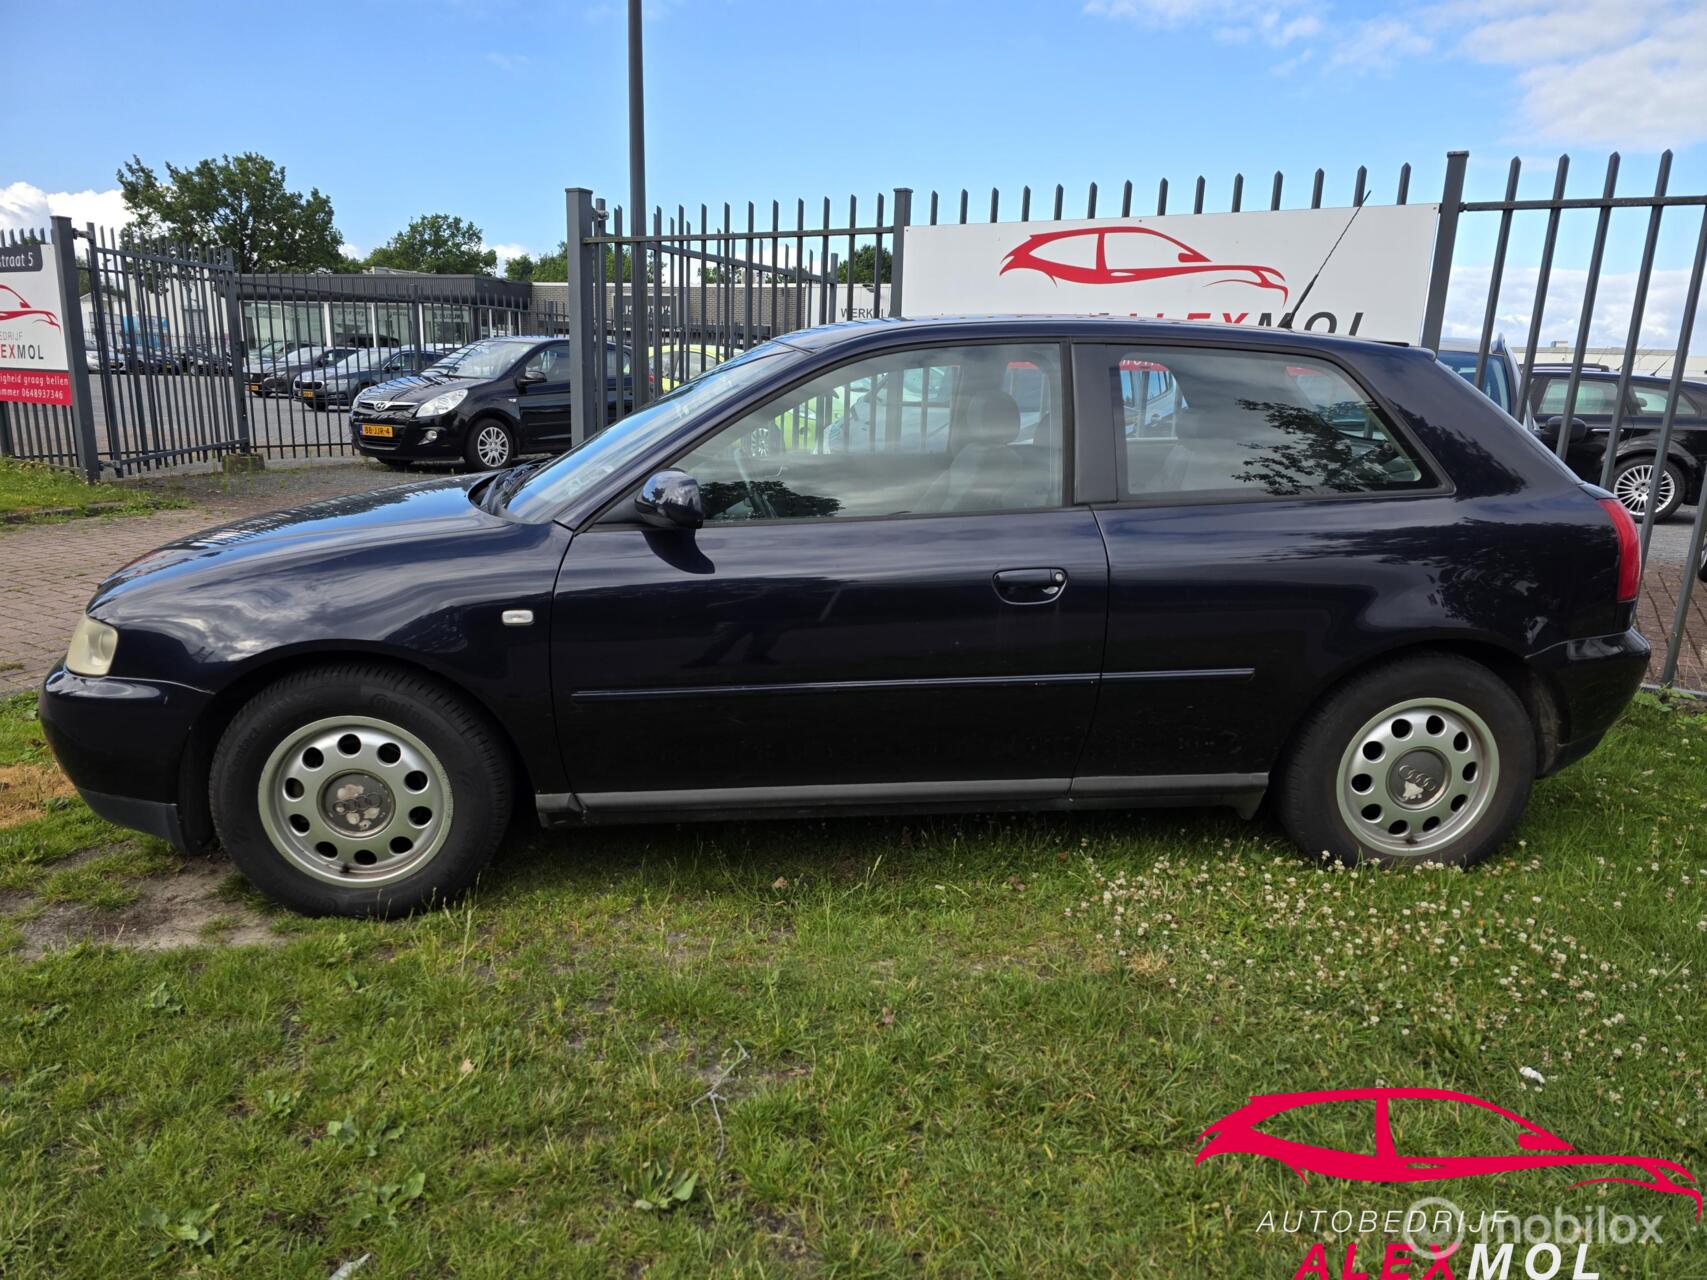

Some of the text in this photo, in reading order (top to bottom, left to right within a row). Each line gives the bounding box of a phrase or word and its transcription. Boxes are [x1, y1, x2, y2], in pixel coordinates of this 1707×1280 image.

[0, 251, 34, 267] traat 5
[23, 376, 44, 387] graag
